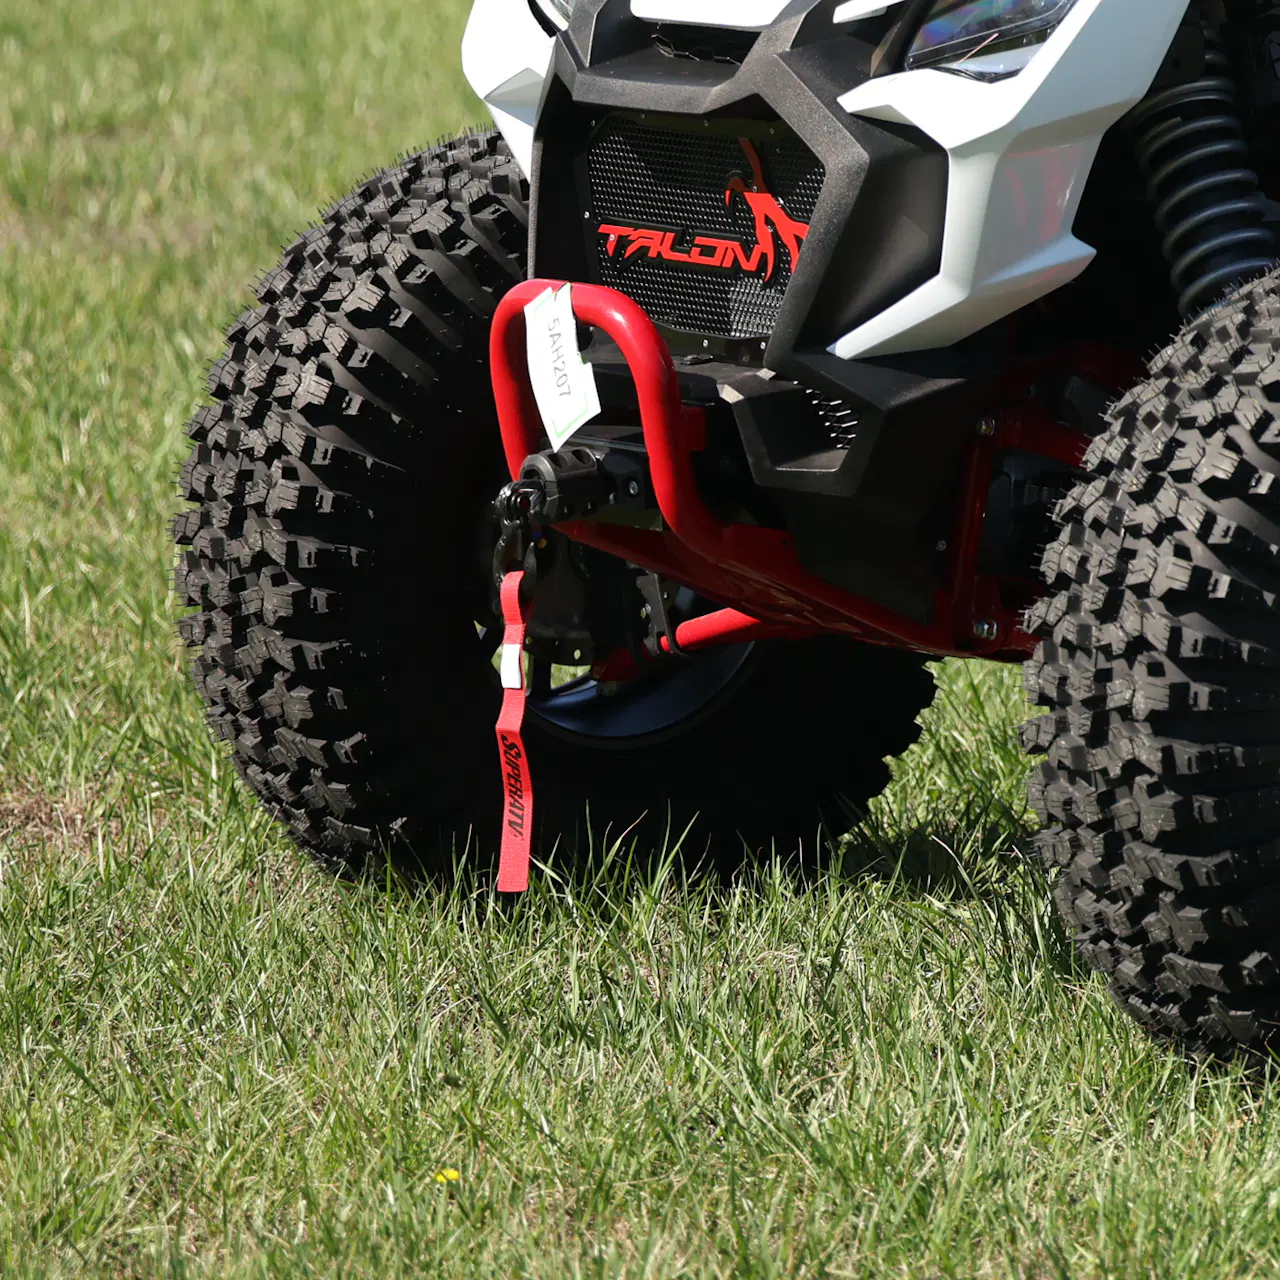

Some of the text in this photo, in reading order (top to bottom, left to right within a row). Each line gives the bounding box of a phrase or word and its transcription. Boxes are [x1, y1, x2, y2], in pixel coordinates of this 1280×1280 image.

[597, 223, 763, 272] TALON
[547, 317, 572, 397] 5AH207
[500, 734, 526, 838] SUPERATV
